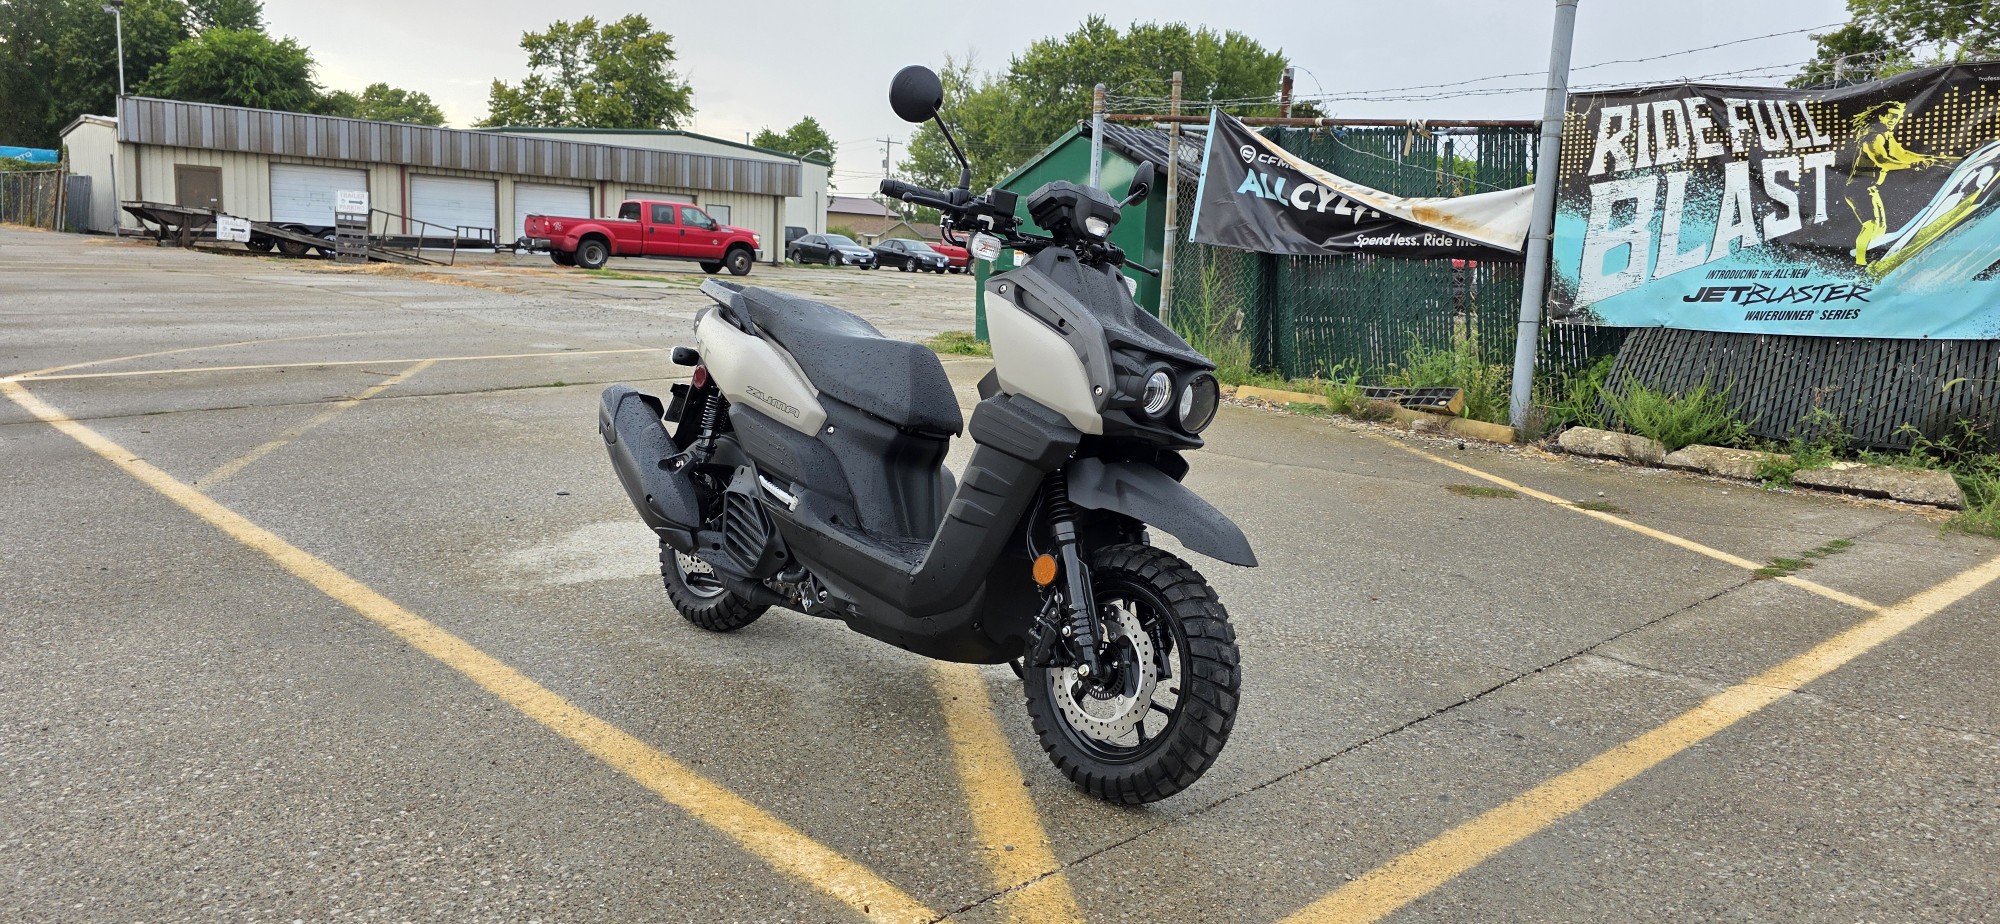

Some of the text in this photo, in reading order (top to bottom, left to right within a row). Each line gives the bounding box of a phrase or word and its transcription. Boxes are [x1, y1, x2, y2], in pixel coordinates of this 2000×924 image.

[1588, 96, 1832, 176] RIDE FULL
[1257, 153, 1297, 170] CFM
[1570, 151, 1836, 312] BLAST
[1354, 233, 1394, 248] Spend
[1394, 233, 1420, 247] less.
[1424, 233, 1453, 247] Ride
[1705, 268, 1811, 280] INTRODUCING THE ALL-NEW
[1819, 308, 1861, 321] SERIES
[746, 385, 801, 419] ZUMA
